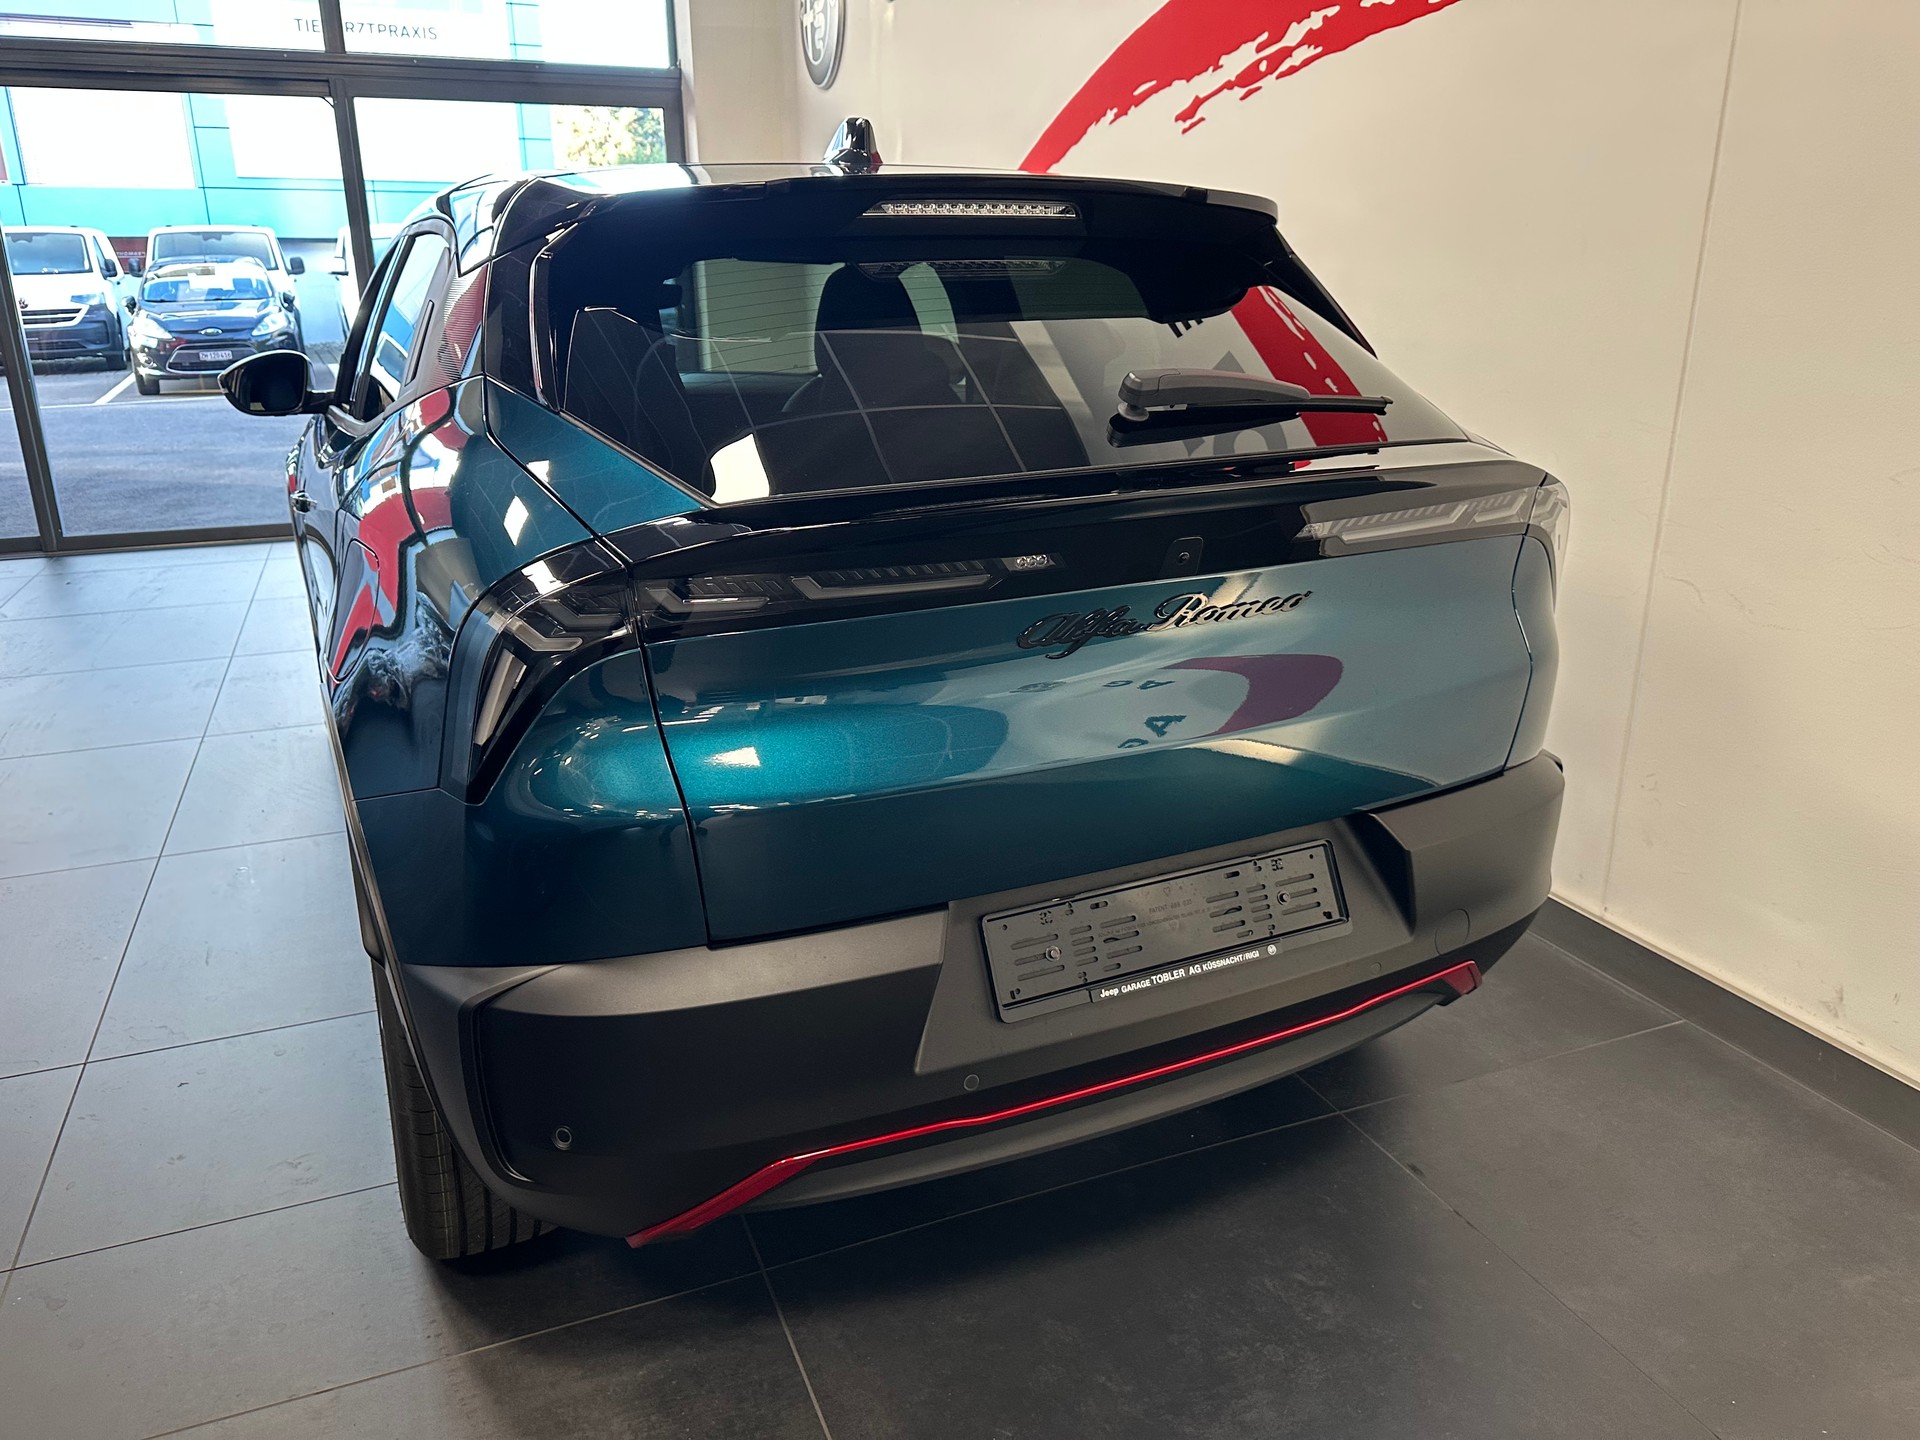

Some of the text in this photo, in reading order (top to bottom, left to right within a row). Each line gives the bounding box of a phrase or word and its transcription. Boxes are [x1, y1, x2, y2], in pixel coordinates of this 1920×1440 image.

[1016, 591, 1313, 660] Alfa Romeo
[1100, 951, 1260, 998] Jeep GARAGE TOBLER AG KÜSSNACHT/RIGI
